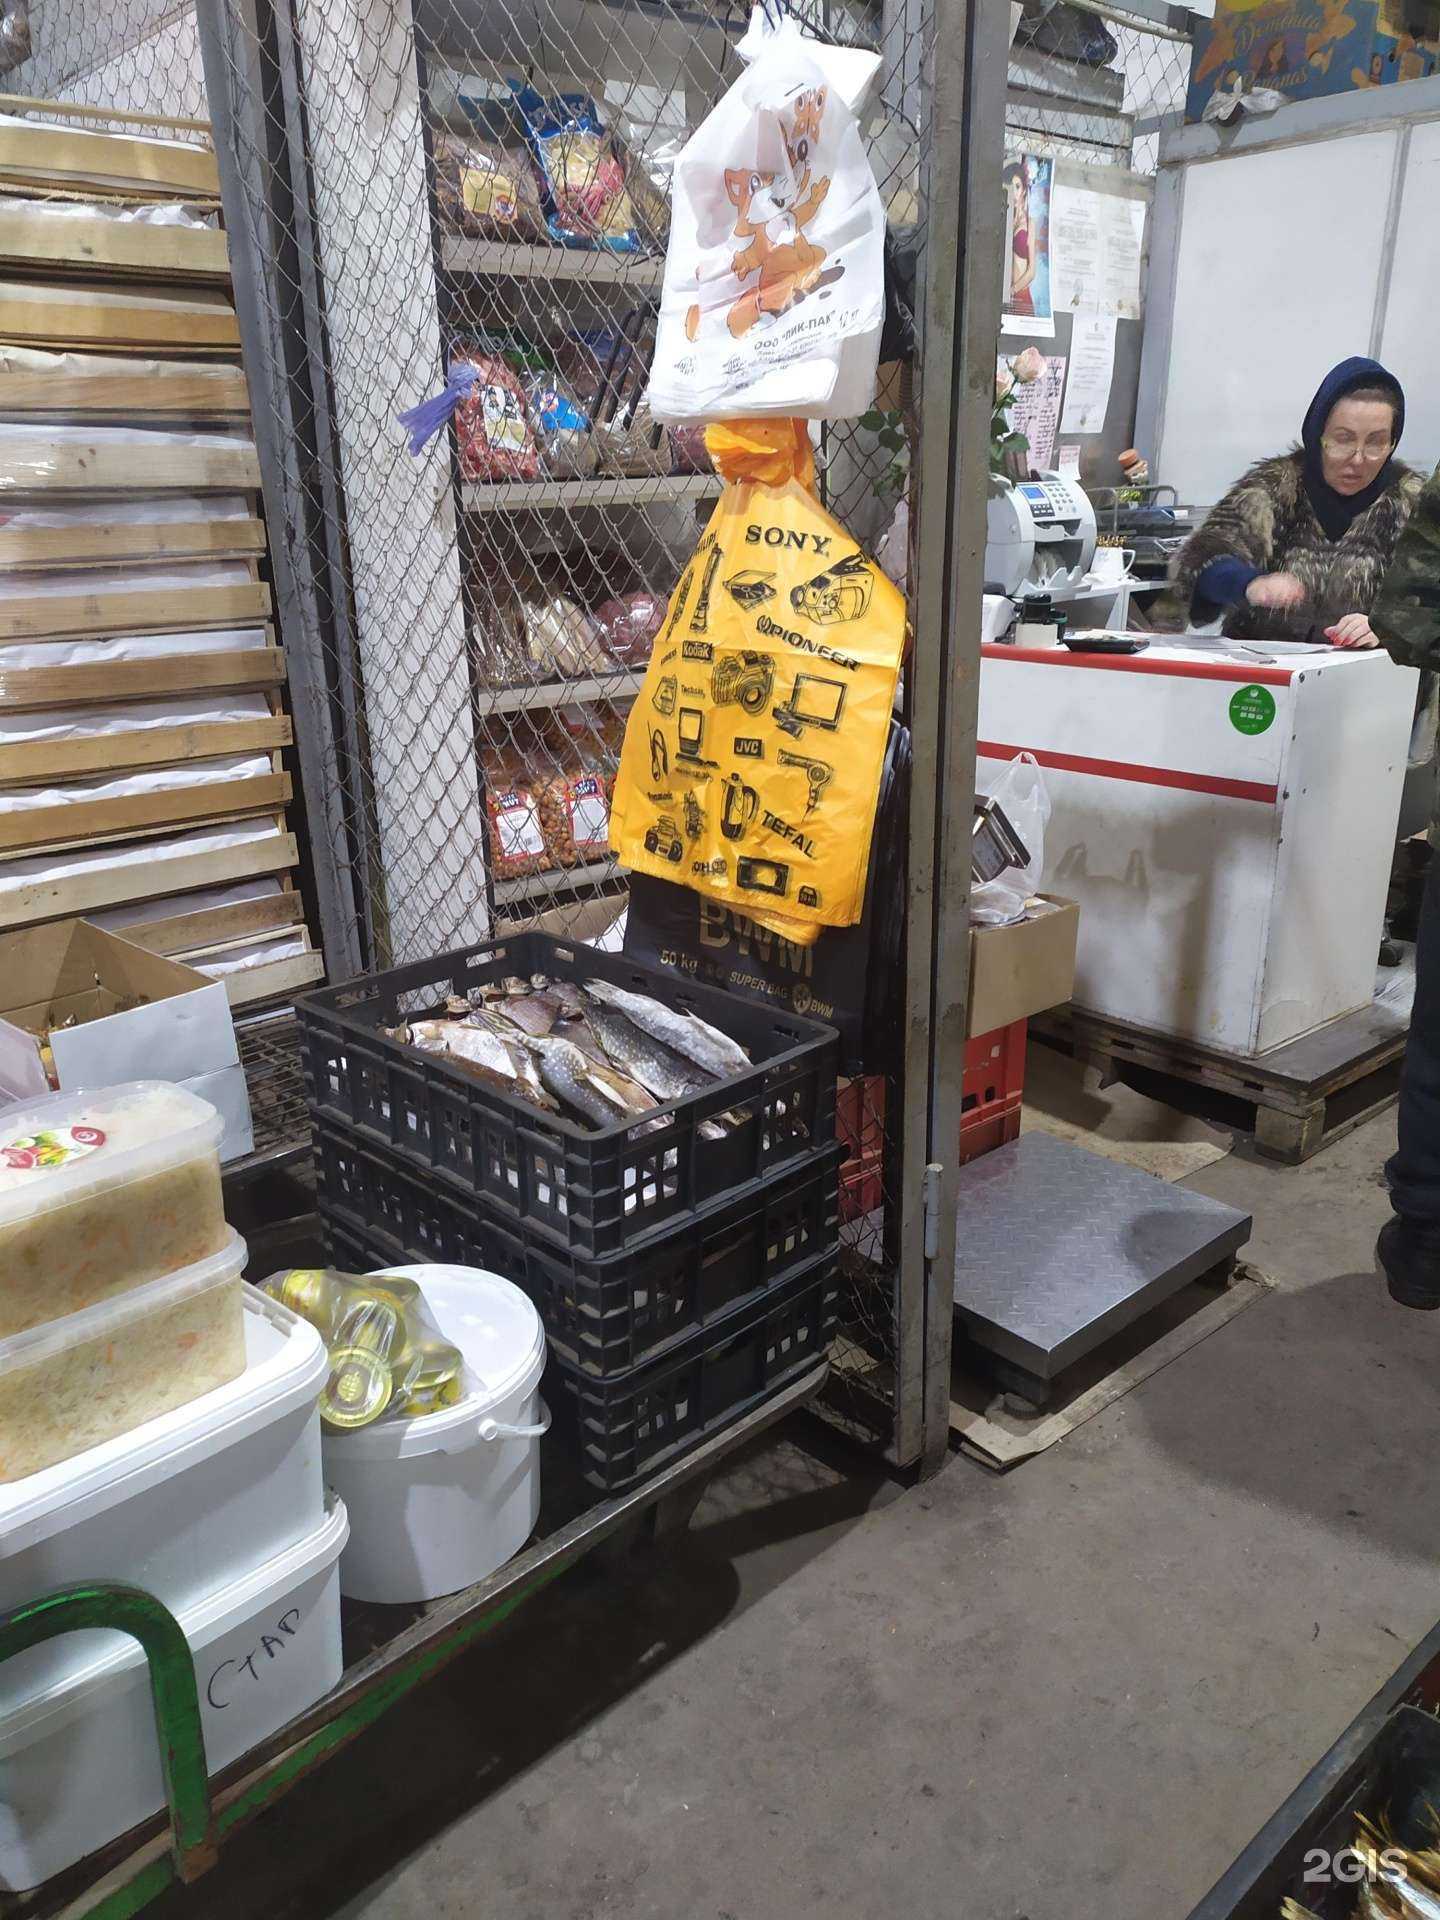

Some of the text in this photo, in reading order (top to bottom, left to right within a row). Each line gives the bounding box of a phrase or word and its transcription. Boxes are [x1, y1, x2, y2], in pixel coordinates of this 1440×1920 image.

[745, 524, 832, 555] SONY
[769, 622, 862, 672] PIONEER
[735, 739, 760, 754] JVC
[762, 809, 815, 858] TEFAL
[660, 950, 677, 966] 50
[681, 953, 698, 974] kg
[729, 971, 767, 993] SUPER
[810, 1000, 834, 1018] BWM
